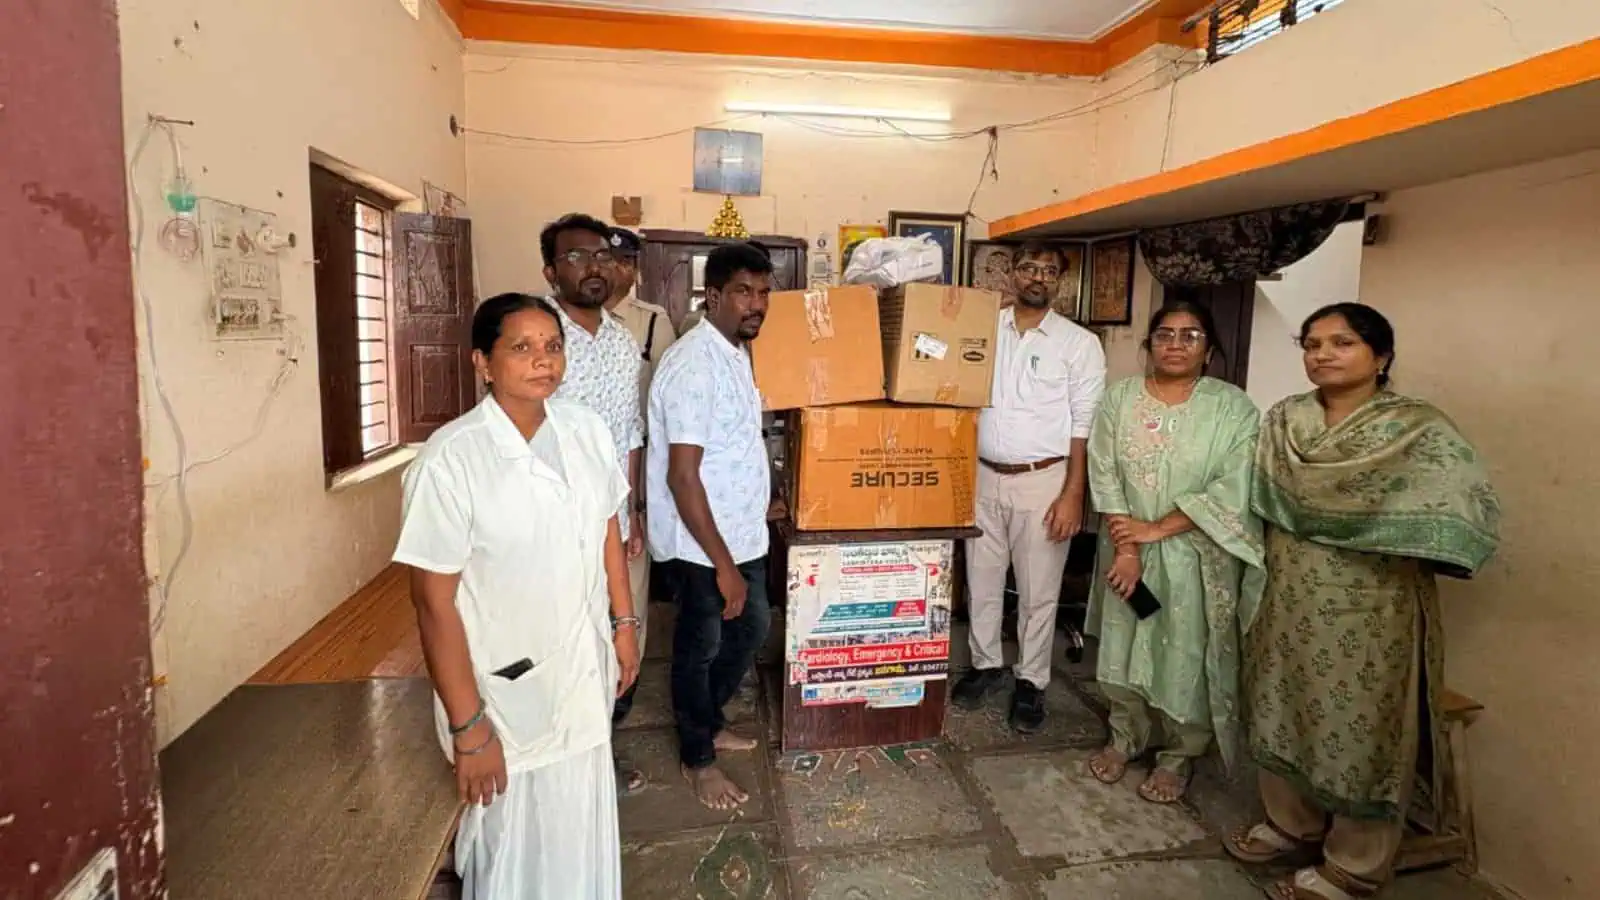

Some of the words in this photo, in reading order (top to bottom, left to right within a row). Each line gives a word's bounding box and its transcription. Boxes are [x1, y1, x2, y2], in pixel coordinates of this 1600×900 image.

[850, 471, 940, 488] SECURE
[853, 646, 902, 662] Emergency
[904, 645, 912, 656] &
[914, 642, 945, 656] Critical
